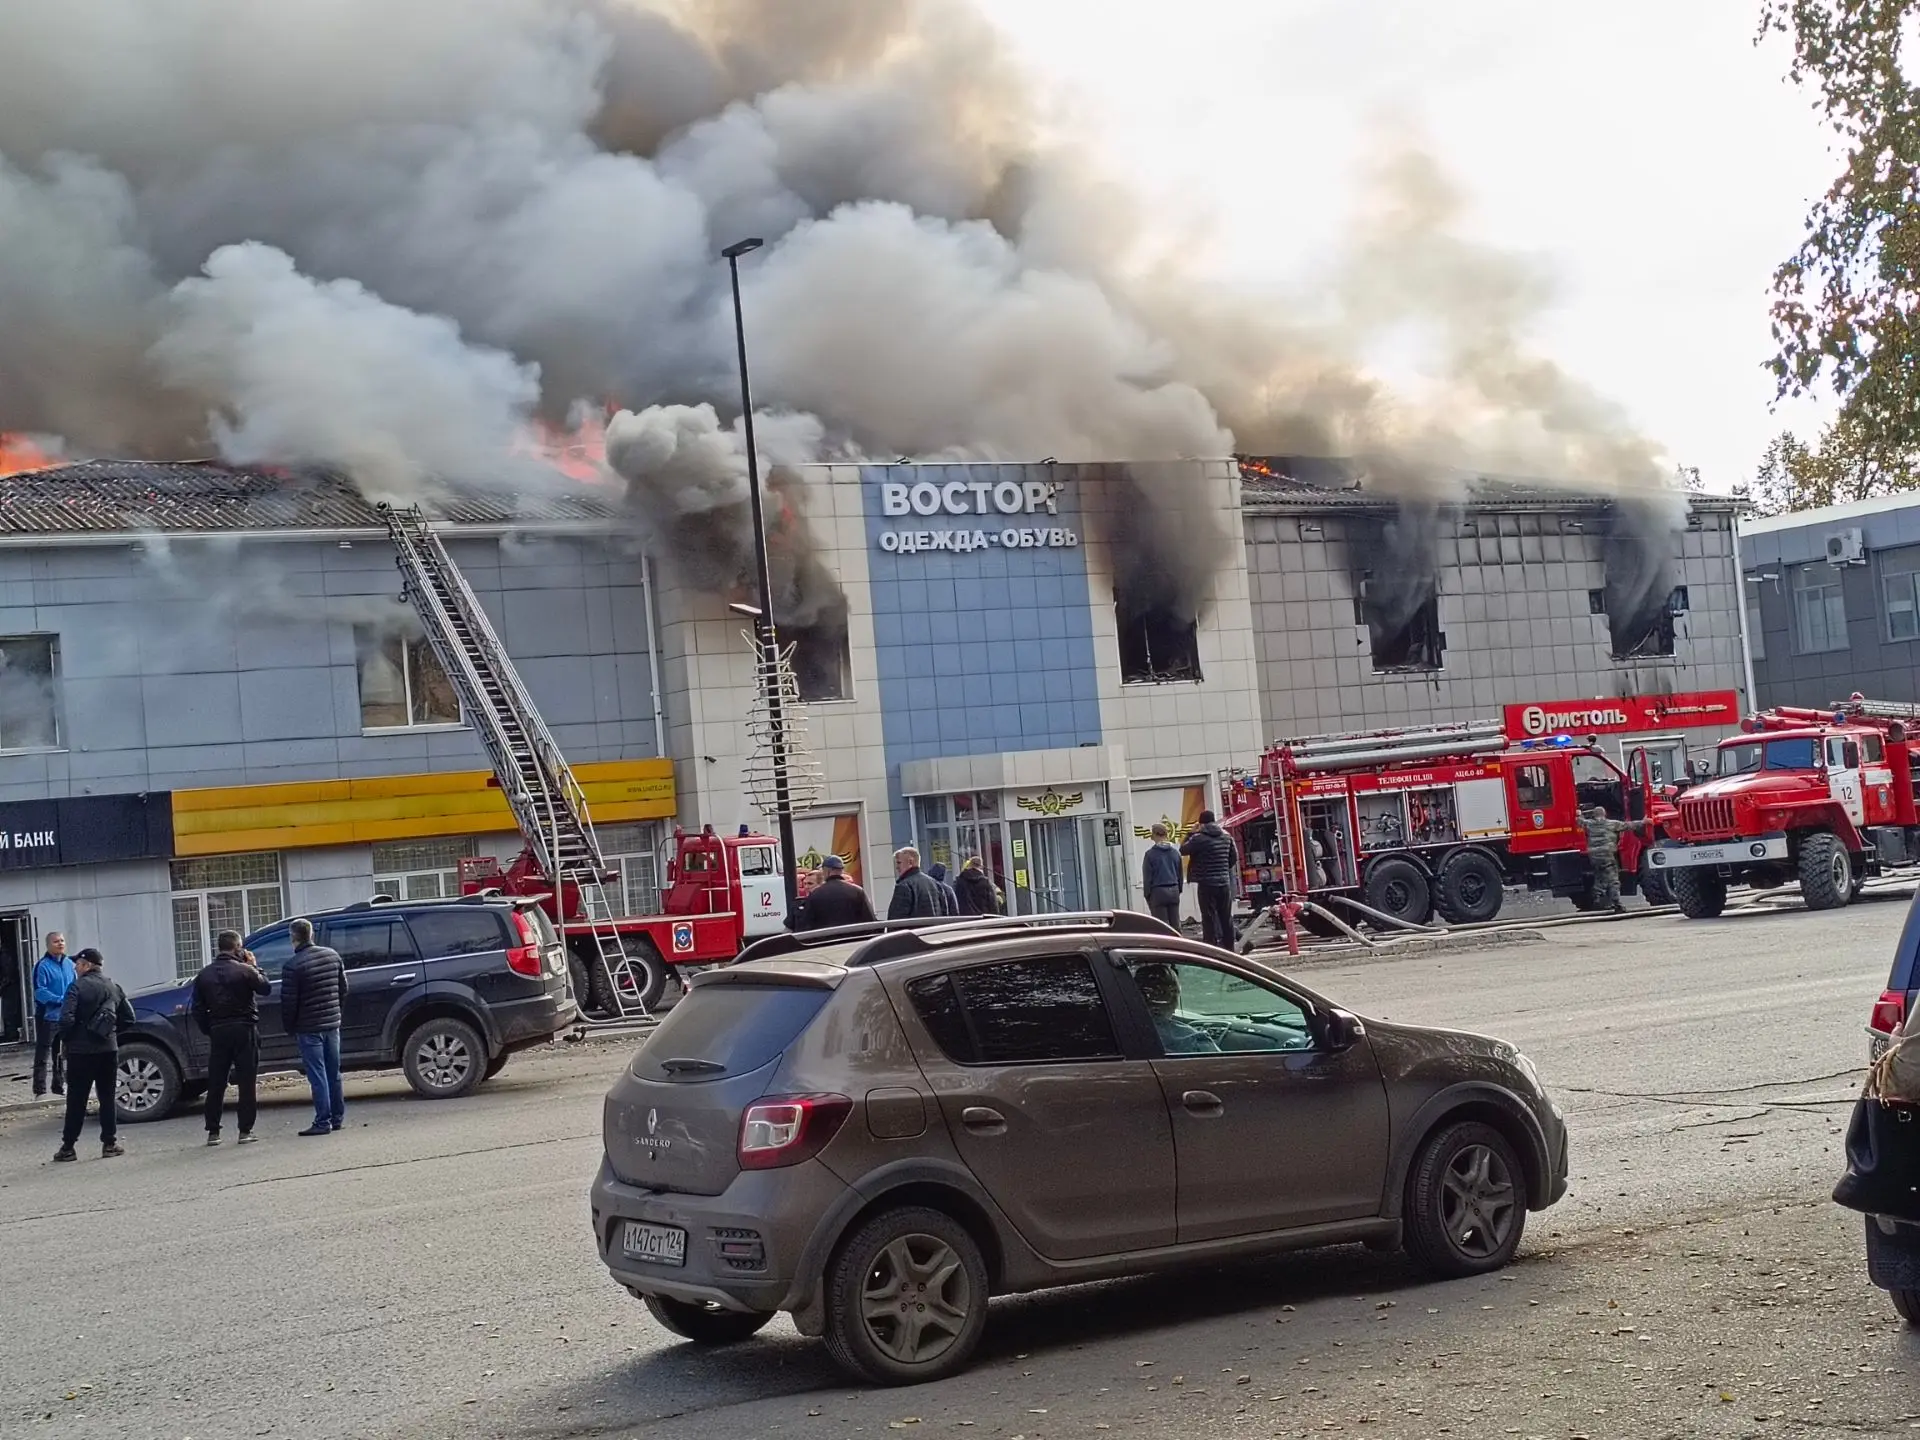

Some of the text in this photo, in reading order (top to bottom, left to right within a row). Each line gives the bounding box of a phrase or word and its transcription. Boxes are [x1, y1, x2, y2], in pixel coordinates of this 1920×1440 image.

[1001, 528, 1078, 548] ОБУВЬ
[1522, 706, 1627, 735] Бристоль
[1841, 786, 1852, 800] 12
[14, 831, 55, 848] БАНК
[761, 892, 772, 906] 12
[634, 1137, 671, 1148] SANDERO
